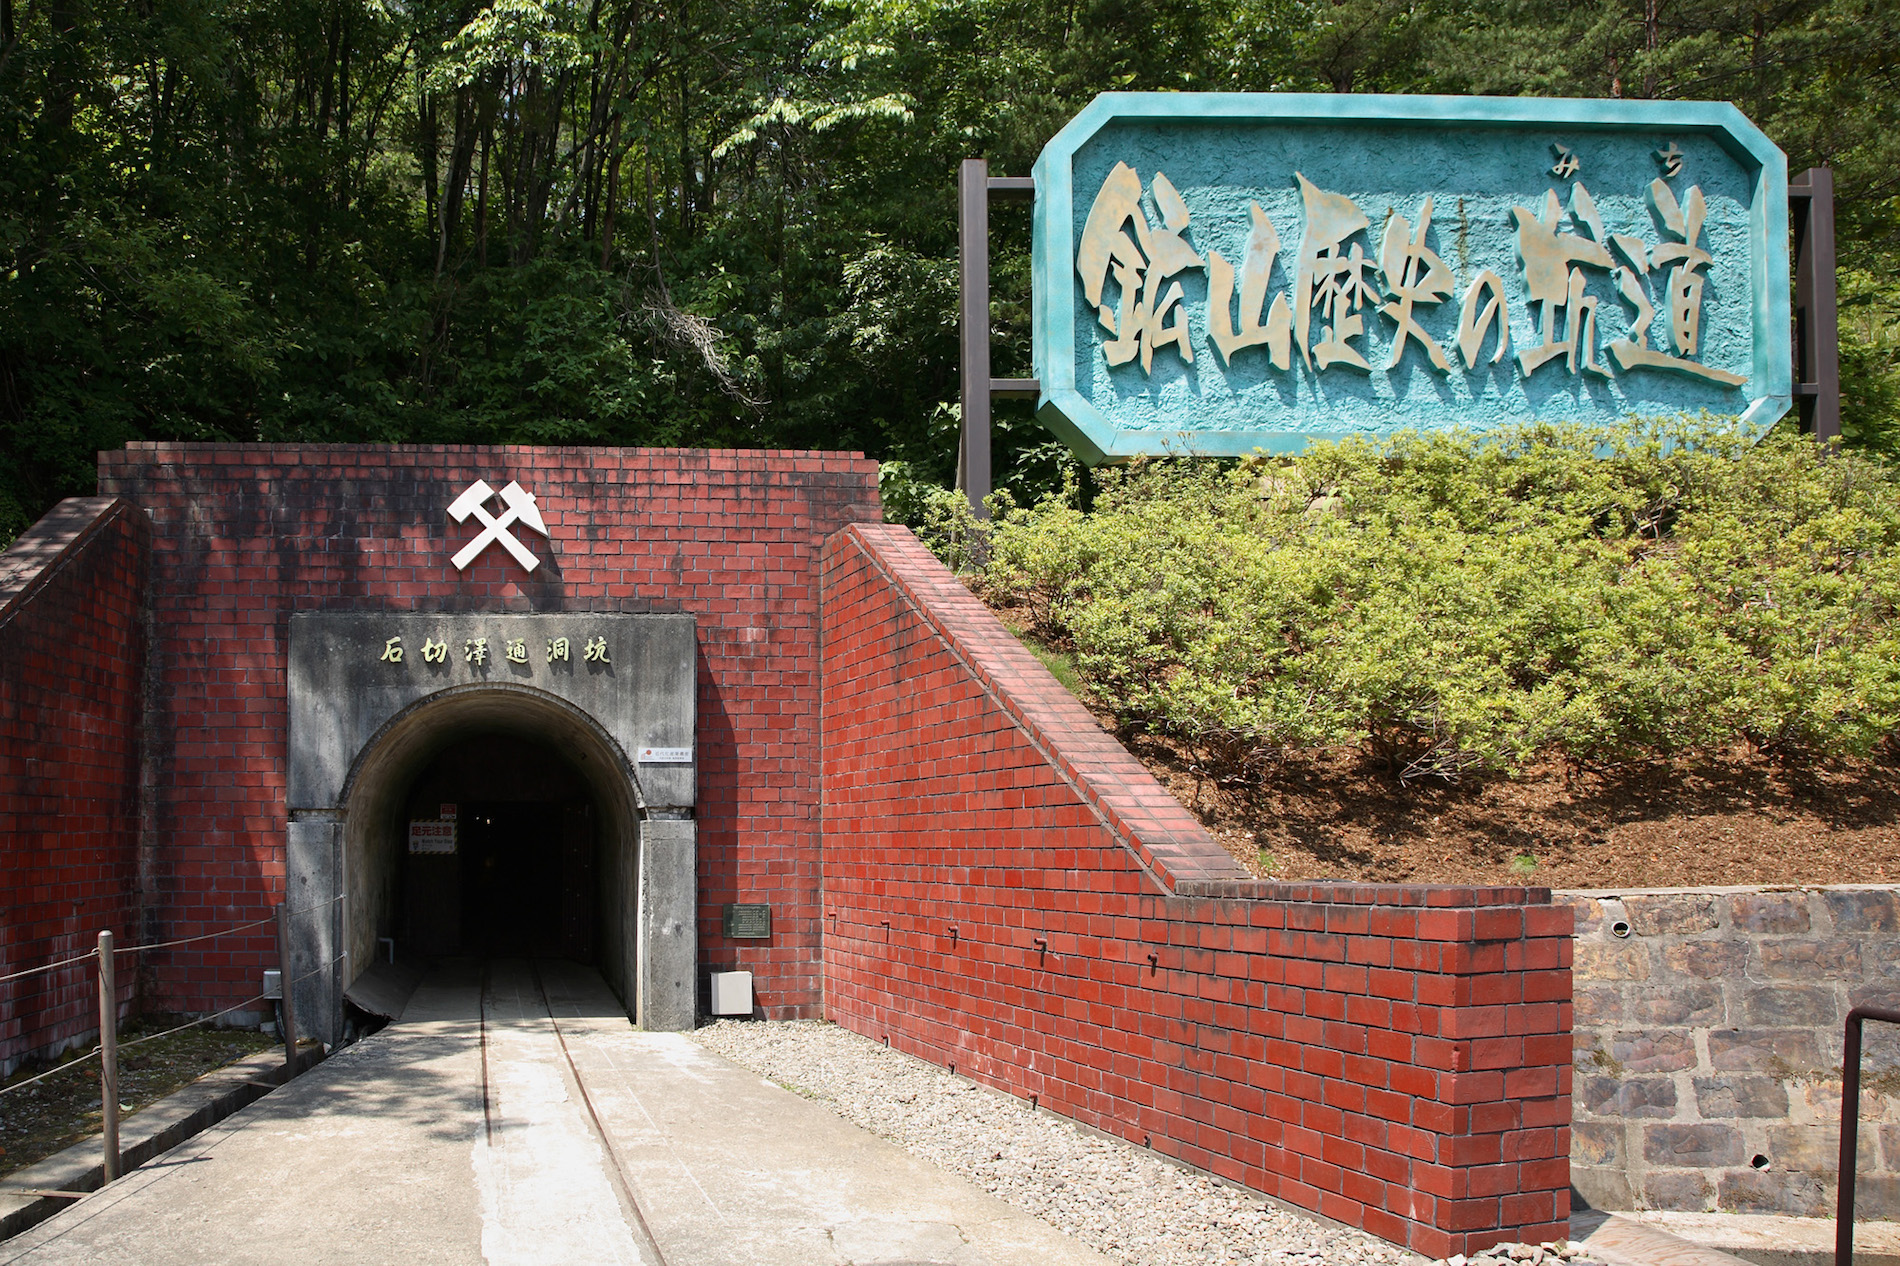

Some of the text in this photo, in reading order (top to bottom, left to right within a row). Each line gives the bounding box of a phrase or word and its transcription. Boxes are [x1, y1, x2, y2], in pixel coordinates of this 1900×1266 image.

[380, 635, 612, 666] 石切澤通洞坑
[411, 826, 452, 836] 足元注意
